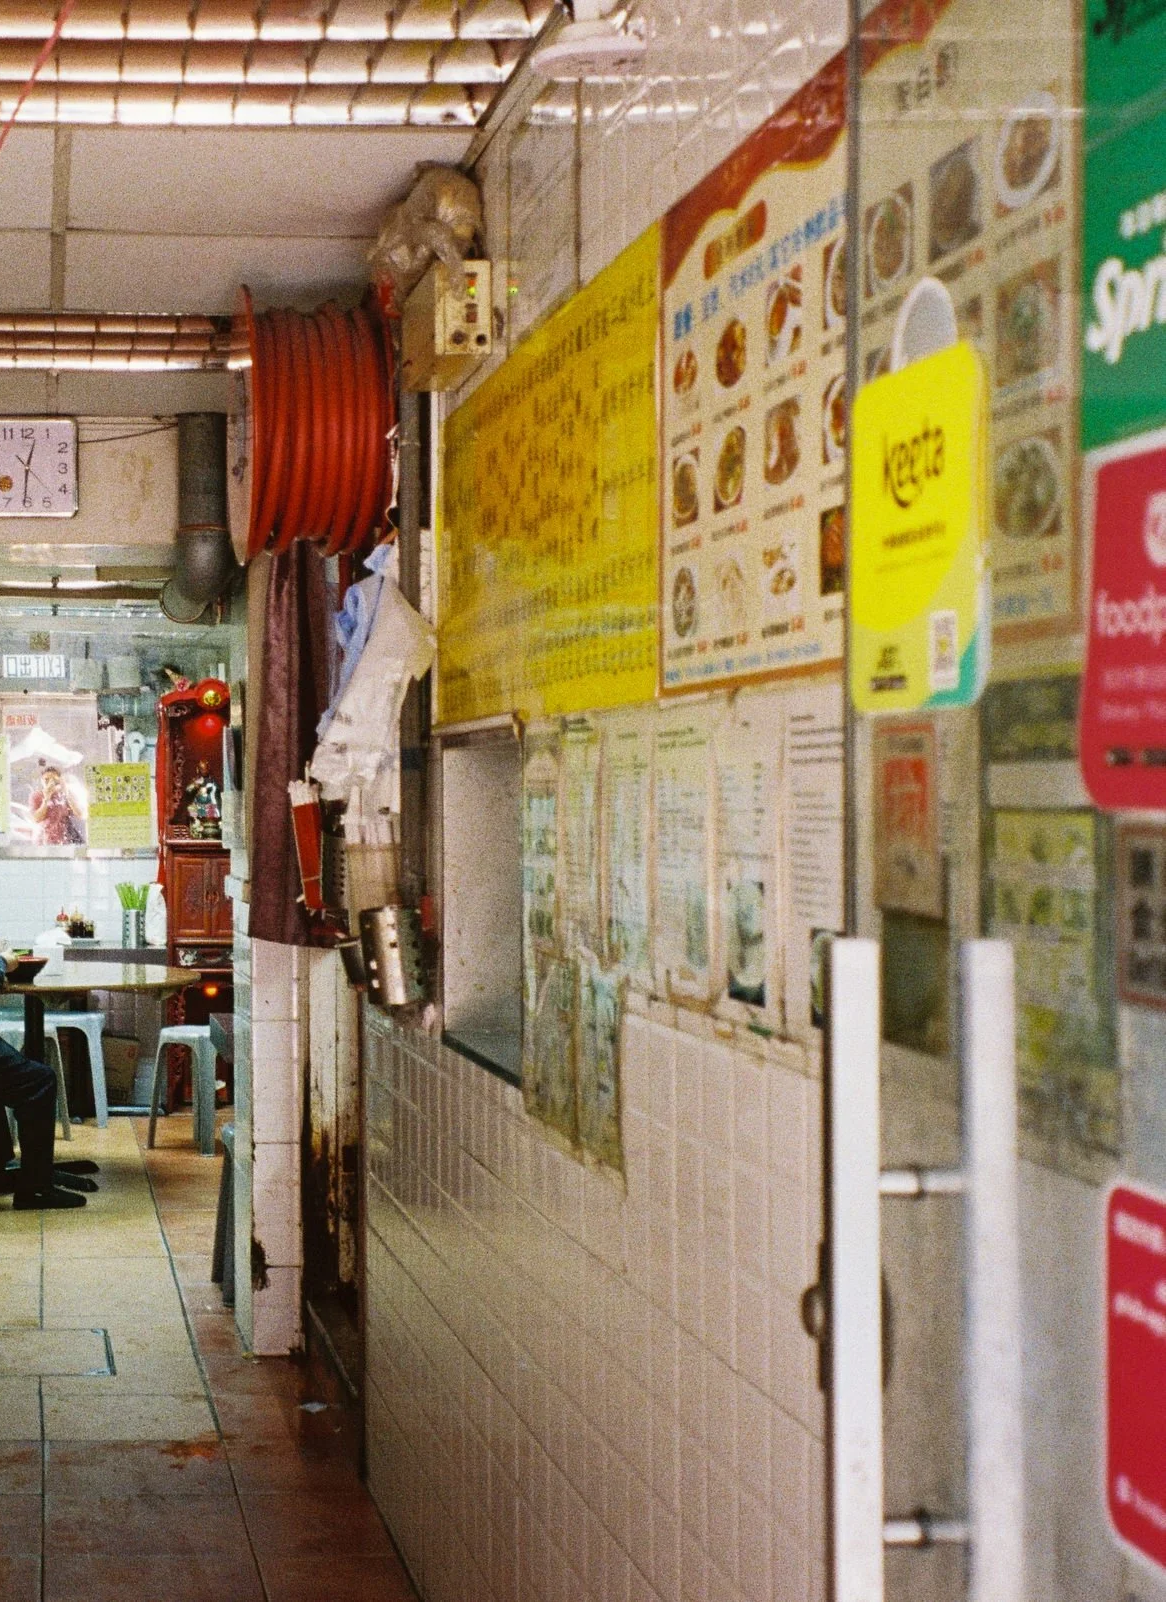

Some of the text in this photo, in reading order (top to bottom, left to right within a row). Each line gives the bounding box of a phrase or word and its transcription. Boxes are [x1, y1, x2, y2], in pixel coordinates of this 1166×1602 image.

[2, 427, 50, 440] 11 12 1
[58, 442, 68, 454] 2
[58, 462, 68, 475] 3
[58, 483, 69, 495] 4
[2, 496, 52, 509] 7 6 5
